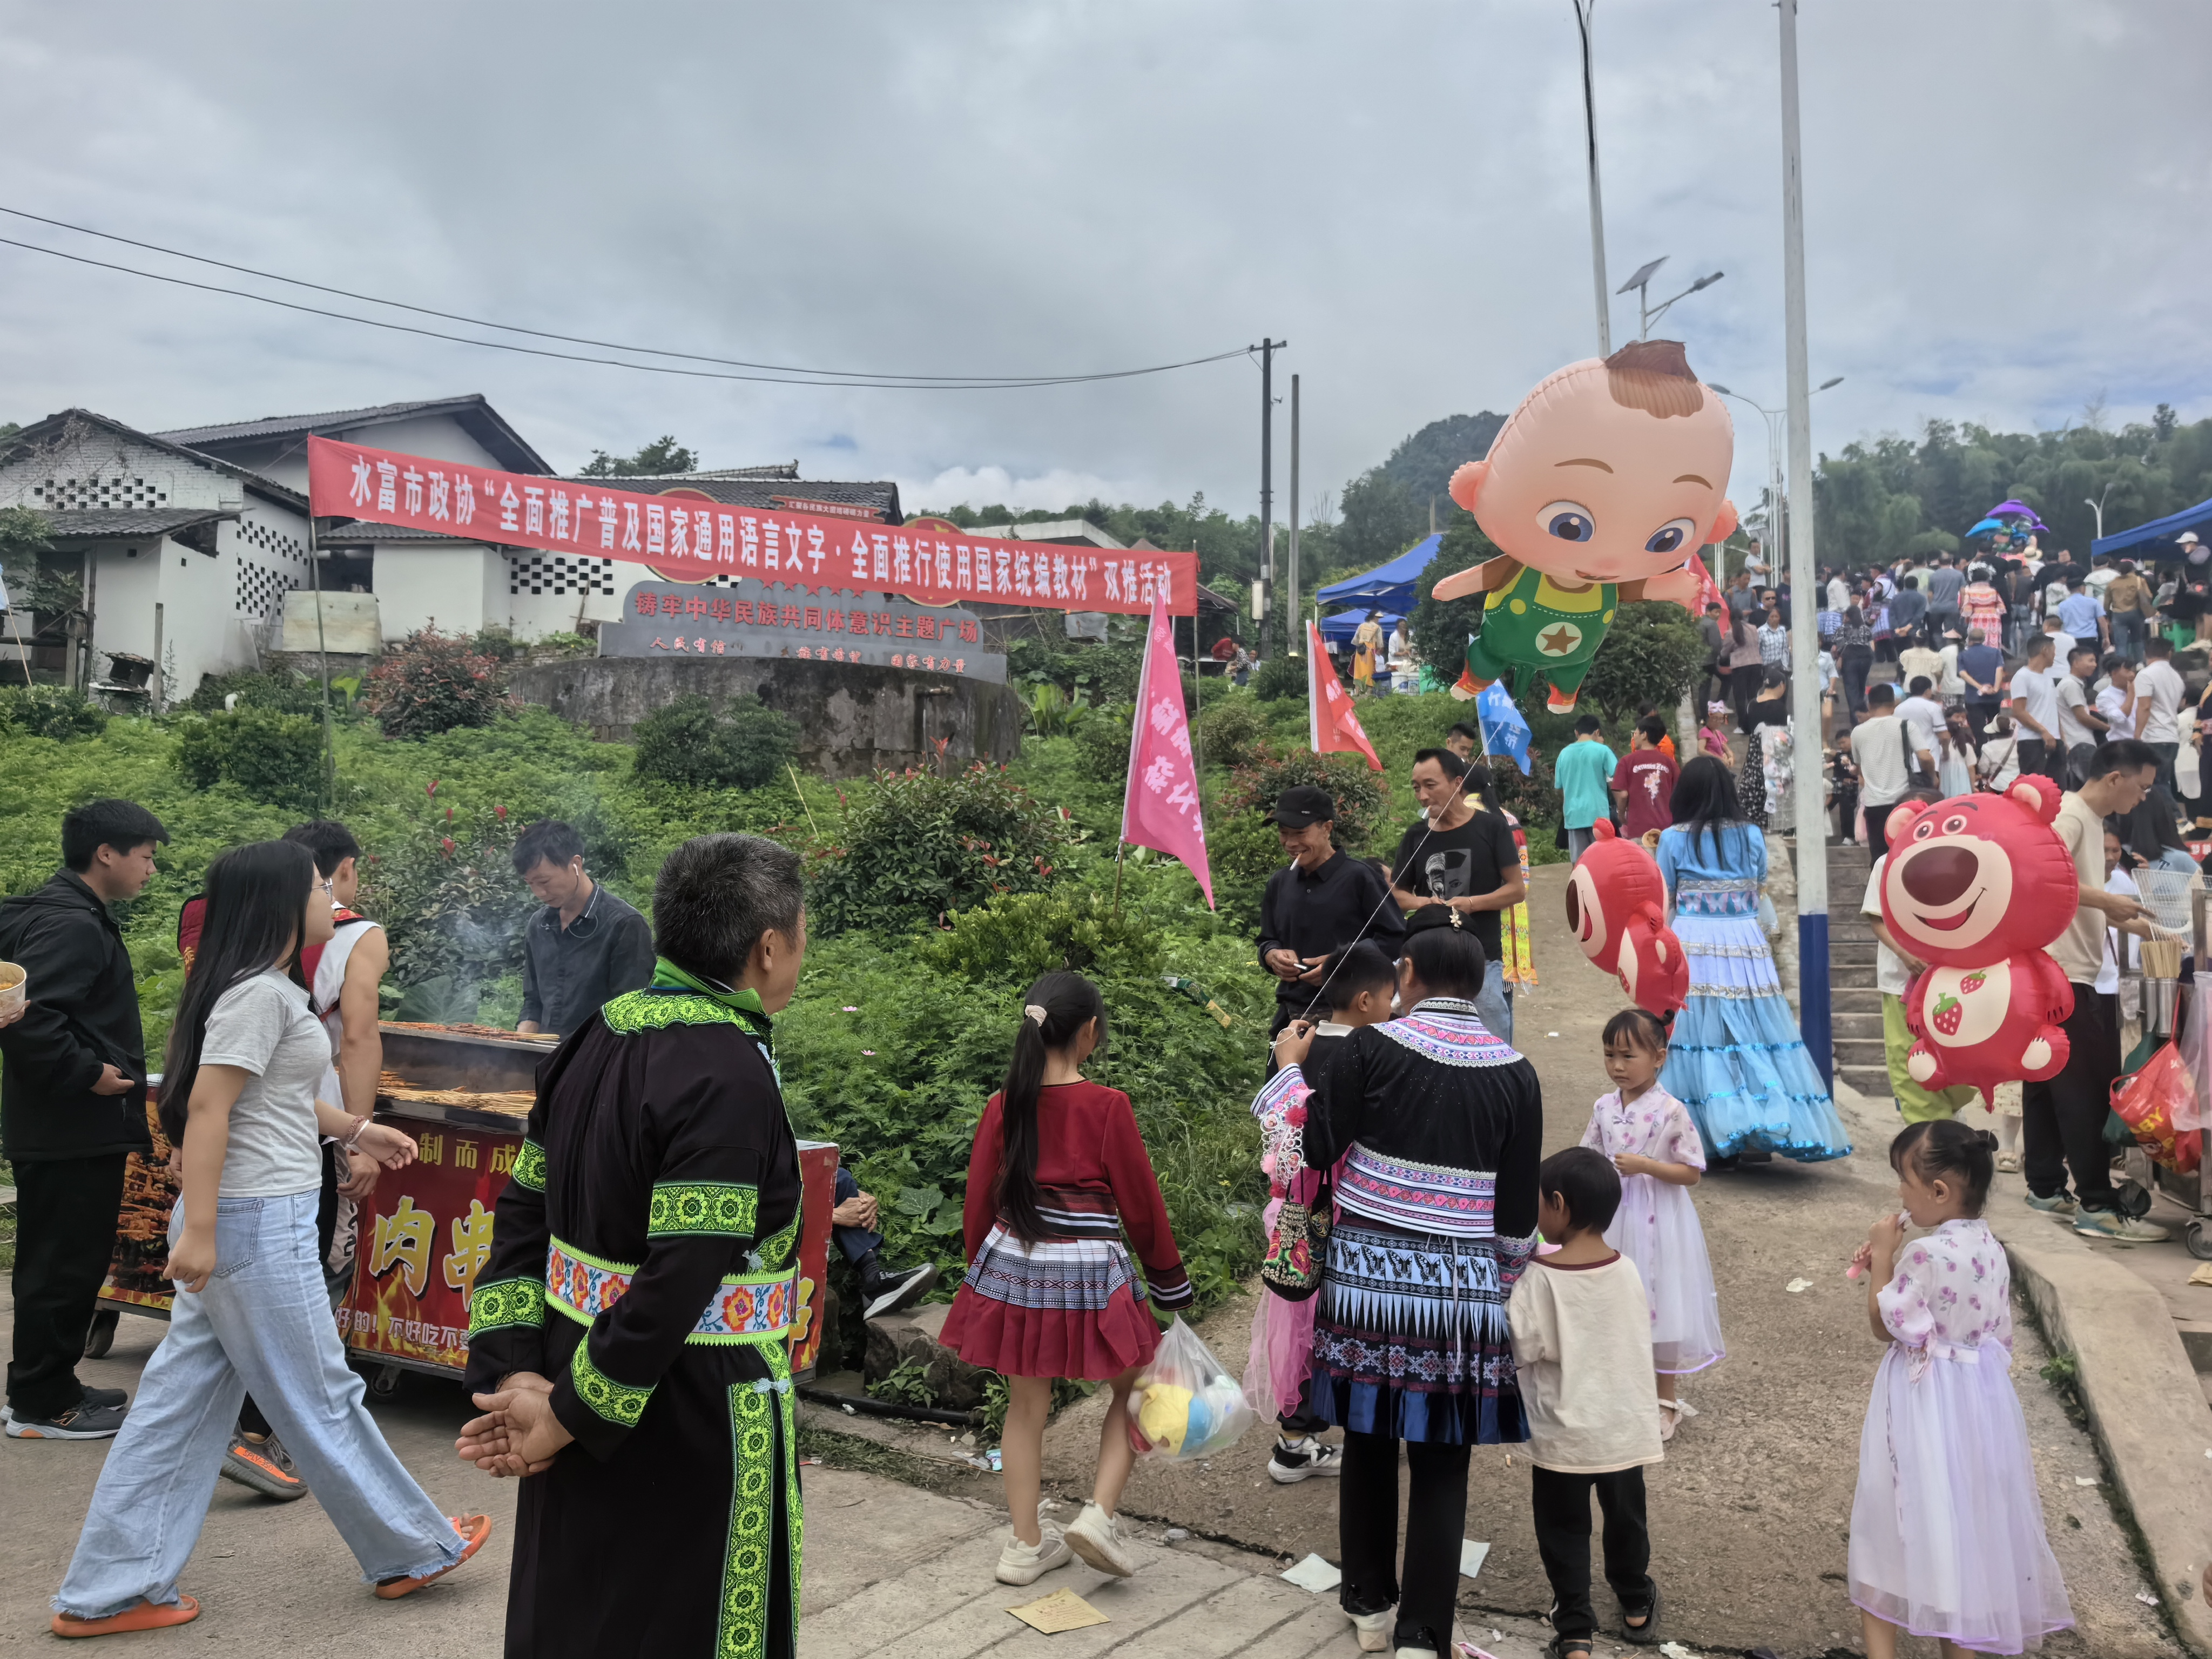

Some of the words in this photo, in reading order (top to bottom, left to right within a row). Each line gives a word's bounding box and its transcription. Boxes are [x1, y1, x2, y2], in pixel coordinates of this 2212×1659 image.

[635, 591, 978, 643] 铸牢中华民族共同体意识主题广场
[650, 636, 744, 655] 人民有信
[780, 646, 862, 664] 族有希望
[890, 653, 967, 673] 国家有力量
